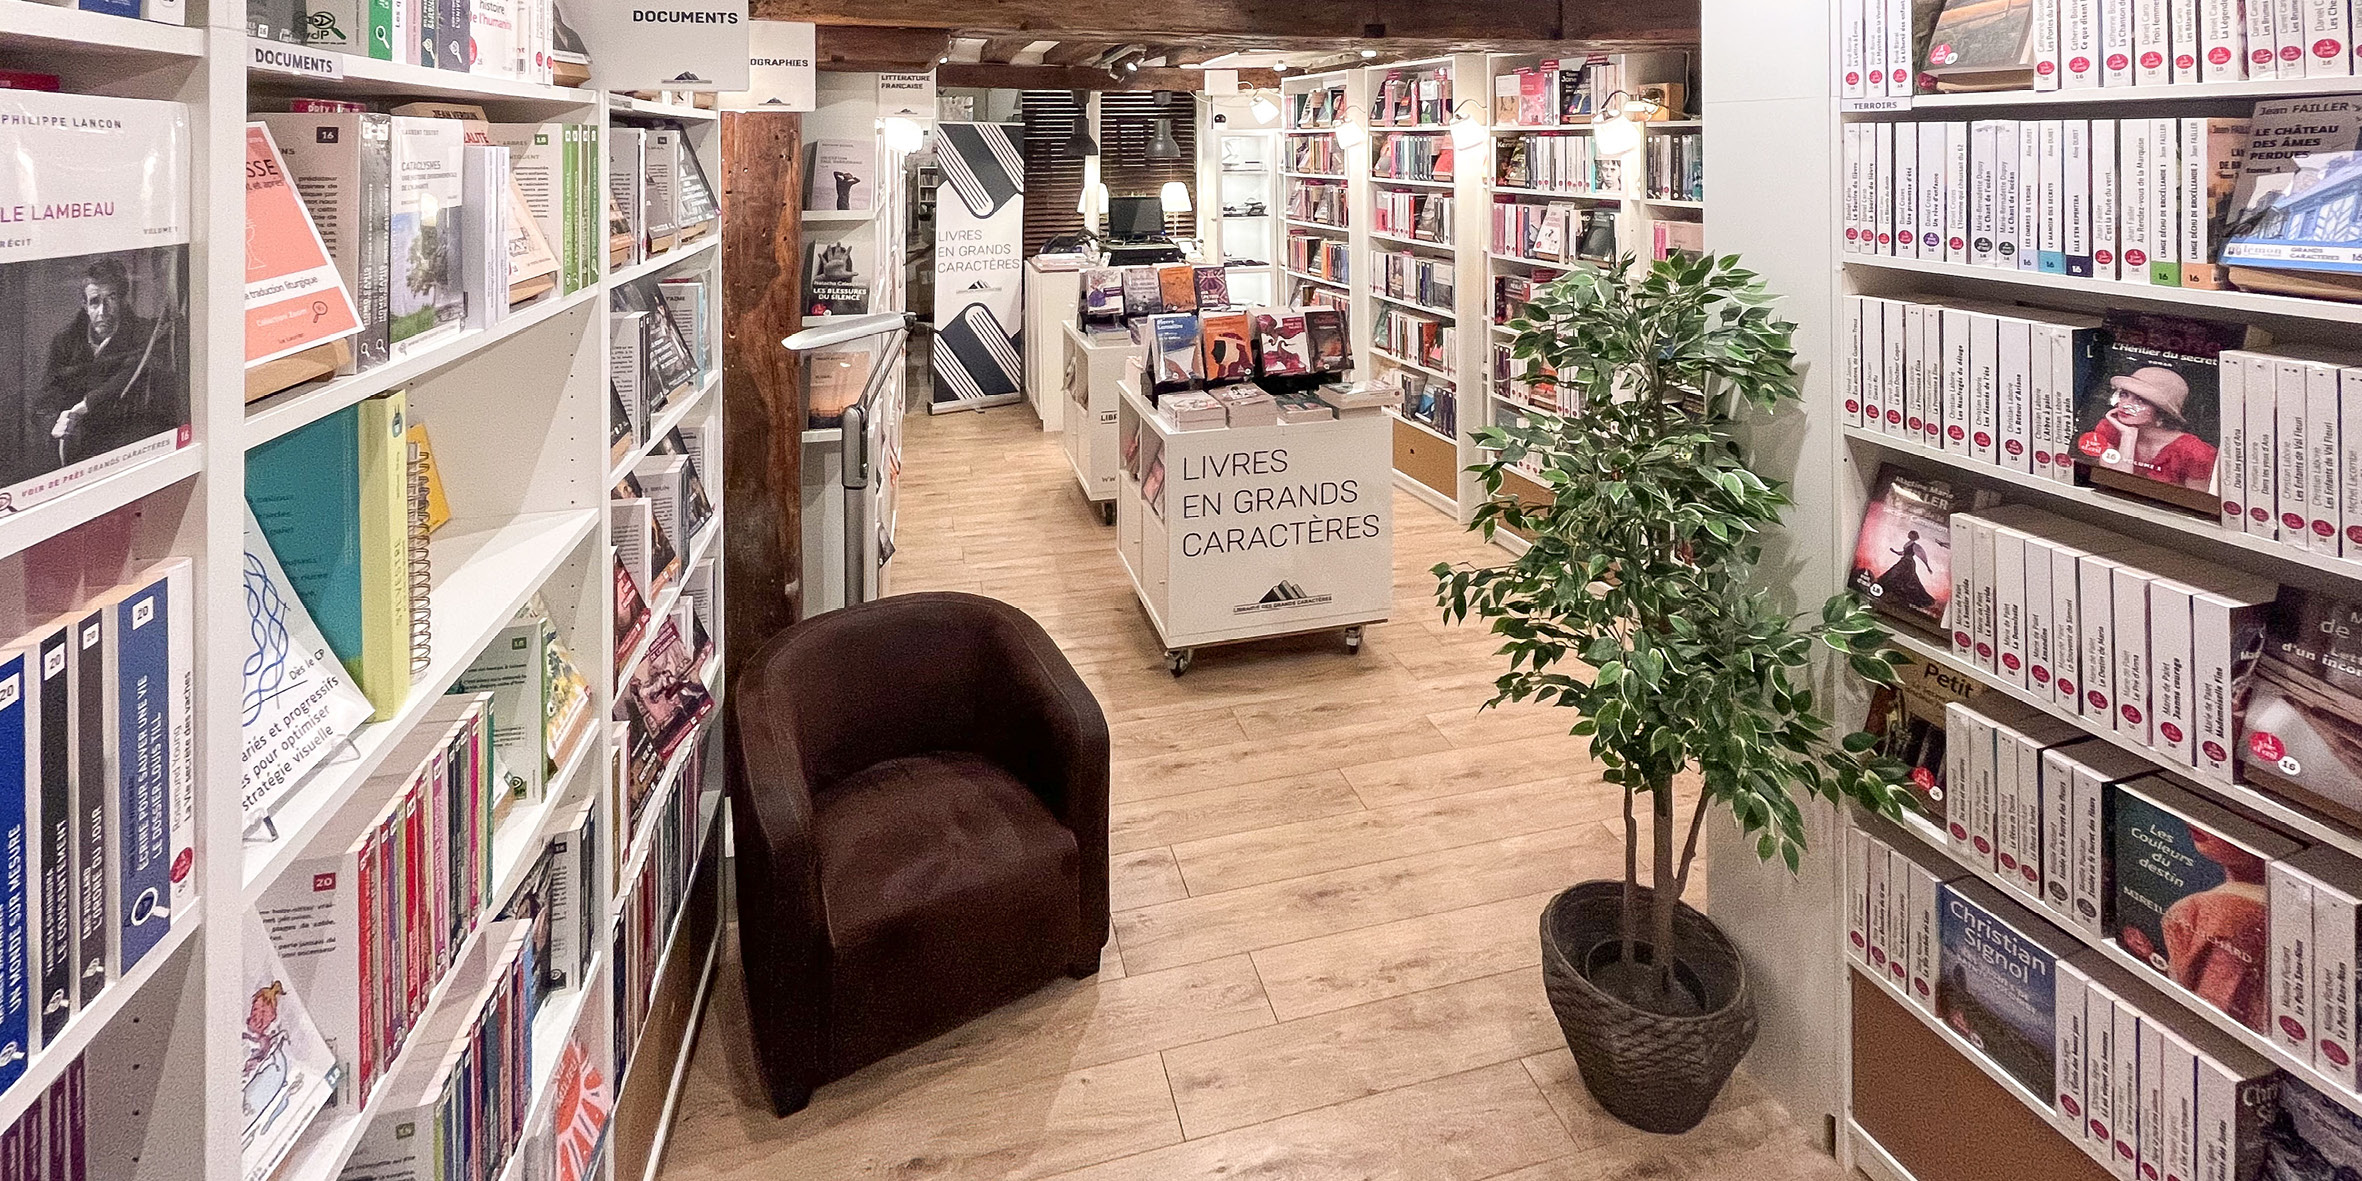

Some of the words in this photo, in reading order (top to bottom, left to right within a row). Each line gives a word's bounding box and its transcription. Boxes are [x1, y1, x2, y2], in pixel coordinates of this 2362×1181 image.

[632, 9, 738, 24] DOCUMENTS
[254, 47, 333, 73] DOCUMENTS
[749, 57, 808, 67] OGRAPHIES
[1853, 101, 1897, 110] TERROIRS
[2258, 106, 2287, 116] Jean
[2292, 102, 2349, 113] FAILLER
[1, 114, 66, 127] PHILIPPE
[321, 130, 334, 140] 16
[2255, 127, 2271, 137] LE
[2274, 124, 2339, 136] CHÂTEAU
[2252, 139, 2278, 149] DES
[2280, 136, 2321, 147] ÂMES
[2137, 138, 2145, 168] Marquise
[2249, 150, 2311, 160] PERDUES
[2104, 188, 2112, 196] du
[2137, 178, 2145, 188] de
[1984, 194, 1992, 202] de
[2104, 198, 2112, 216] faute
[0, 206, 24, 223] LE
[31, 202, 114, 221] LAMBEAU
[1984, 204, 1992, 223] Chant
[2137, 190, 2145, 233] Rendez-vous
[937, 229, 983, 242] LIVRES
[1984, 224, 1992, 232] Le
[2104, 224, 2112, 242] C'est
[0, 239, 32, 248] RÉCIT
[2137, 234, 2145, 243] Au
[937, 246, 955, 258] EN
[957, 243, 1011, 256] GRANDS
[937, 257, 1020, 273] CARACTÈRES
[2158, 272, 2169, 281] 16
[2111, 342, 2160, 356] L'Héritier
[2162, 350, 2178, 359] du
[2180, 354, 2218, 366] secret
[181, 430, 190, 441] 16
[1183, 449, 1288, 481] LIVRES
[1183, 492, 1221, 519] EN
[1233, 480, 1358, 514] GRANDS
[1182, 514, 1380, 558] CARACTÈRES
[137, 605, 149, 621] 20
[50, 654, 61, 670] 20
[136, 674, 148, 698] VIE
[1923, 662, 1974, 699] Petit
[0, 684, 14, 702] 20
[183, 671, 192, 712] vaches
[136, 698, 148, 728] UNE
[268, 723, 282, 738] et
[283, 675, 340, 727] progressifs
[151, 712, 162, 742] TILL
[183, 714, 192, 736] des
[172, 725, 182, 766] Young
[253, 747, 277, 776] pour
[281, 704, 330, 750] optimiser
[136, 729, 148, 781] SAUVER
[151, 742, 162, 780] LOUIS
[241, 761, 293, 811] stratégie
[292, 725, 333, 762] visuelle
[2281, 761, 2296, 771] 16
[136, 781, 148, 818] POUR
[183, 785, 192, 802] Vie
[151, 780, 162, 837] DOSSIER
[183, 806, 192, 822] La
[2149, 824, 2174, 843] Les
[151, 837, 162, 858] LE
[2131, 828, 2194, 867] Couleurs
[7, 824, 21, 892] MESURE
[2152, 853, 2171, 868] du
[316, 877, 333, 887] 20
[2139, 858, 2184, 888] destin
[7, 892, 21, 926] SUR
[1950, 900, 2046, 976] Christian
[7, 926, 21, 986] MONDE
[1964, 927, 2028, 984] Signol
[7, 986, 21, 1014] UN
